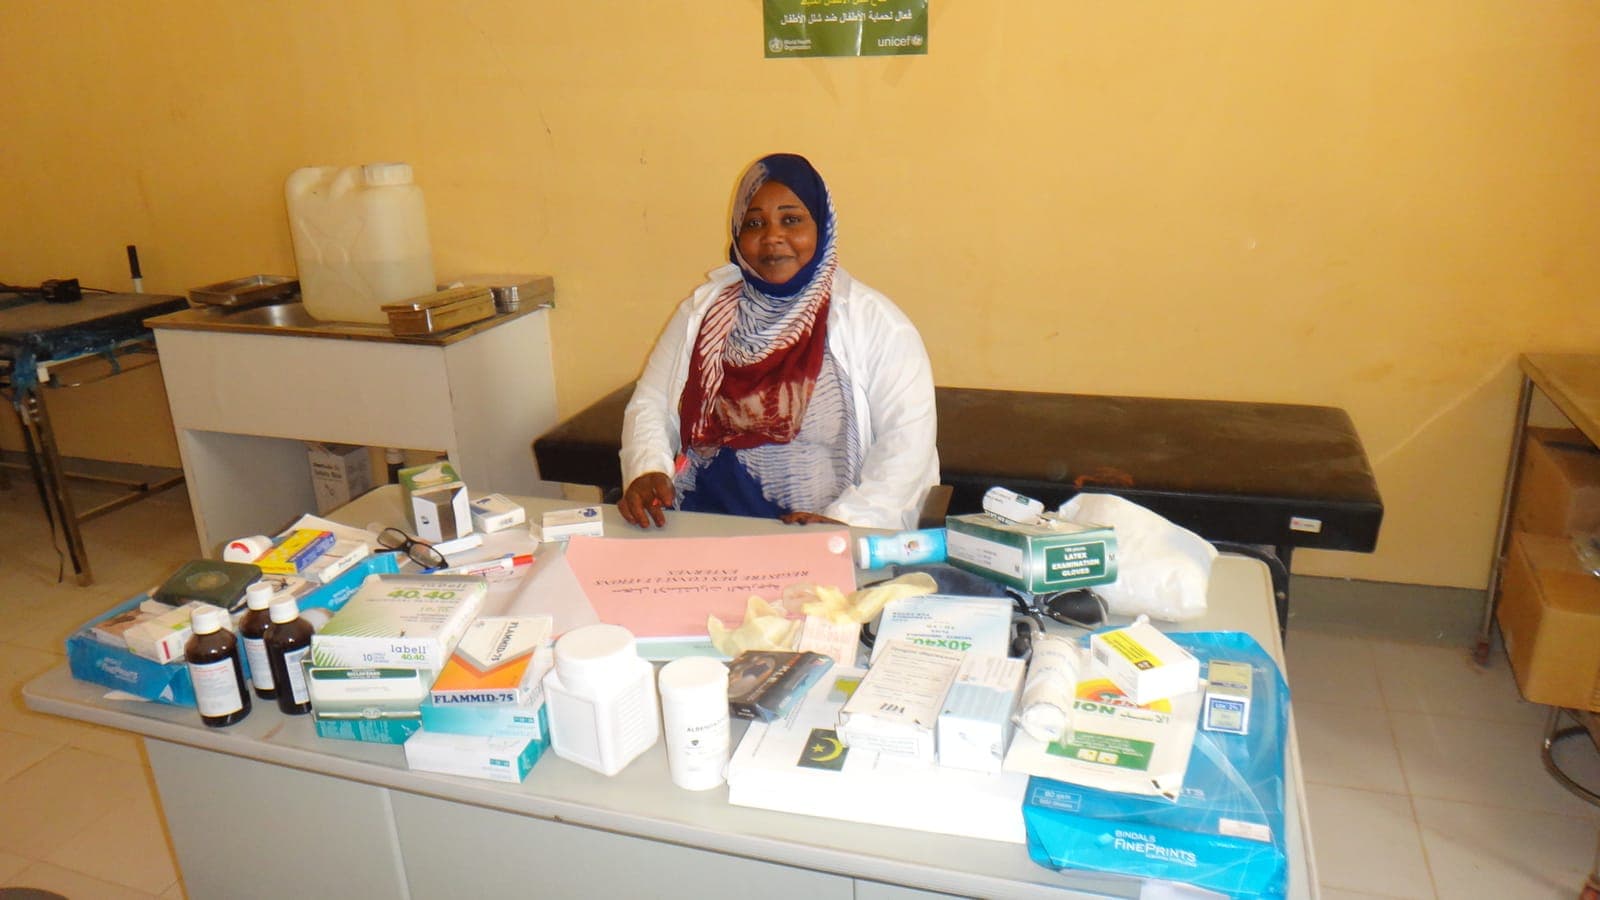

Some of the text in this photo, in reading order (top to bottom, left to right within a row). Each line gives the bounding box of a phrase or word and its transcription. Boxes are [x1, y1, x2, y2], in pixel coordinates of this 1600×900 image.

[824, 11, 838, 22] ضد
[877, 36, 911, 47] unicef
[1064, 552, 1088, 560] LATEX
[1051, 558, 1100, 570] EXAMINATION
[1061, 567, 1090, 577] GLOVES
[390, 645, 427, 654] labell
[363, 653, 373, 662] 10
[434, 693, 514, 704] FLAMMID-75
[1115, 829, 1156, 843] BINDALS
